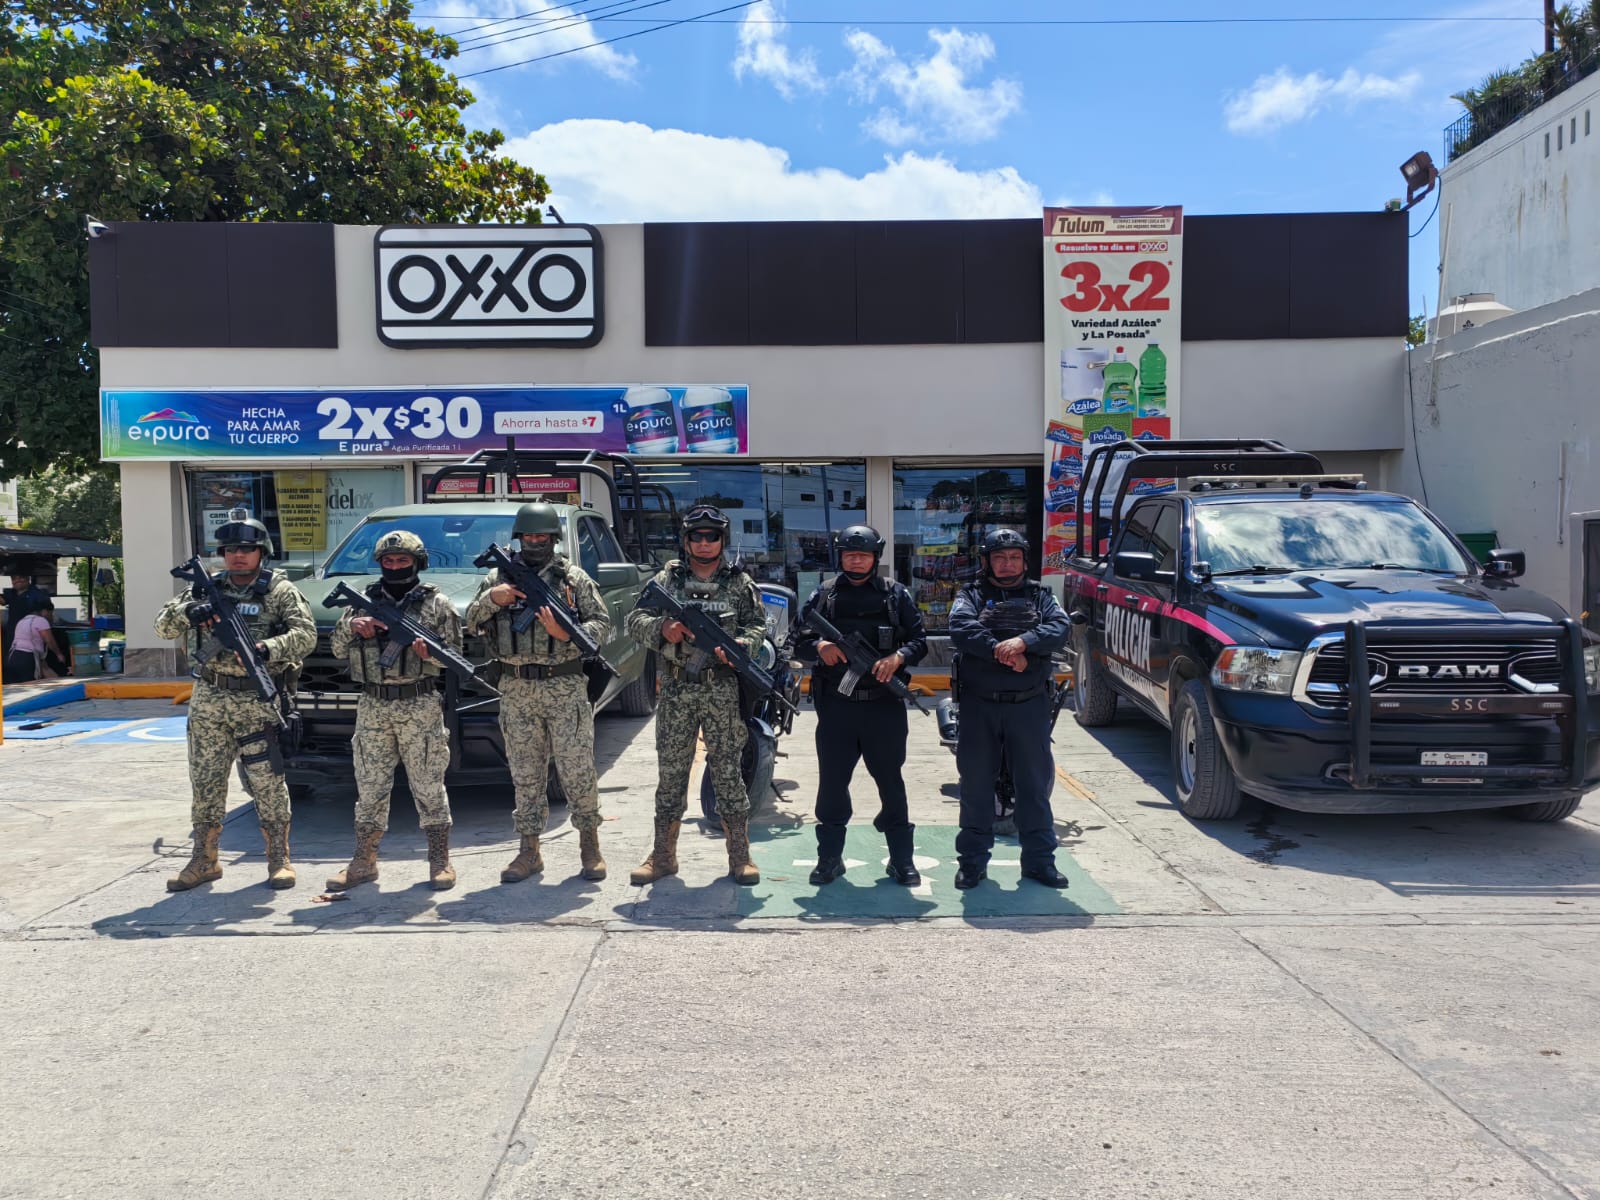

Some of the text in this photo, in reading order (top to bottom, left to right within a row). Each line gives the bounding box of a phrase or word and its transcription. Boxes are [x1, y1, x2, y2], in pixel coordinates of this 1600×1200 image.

[1058, 217, 1105, 233] Tulum
[1140, 242, 1168, 252] OXXO
[387, 247, 587, 320] OXXO
[1071, 318, 1119, 328] Variedad
[1082, 331, 1089, 340] y
[1091, 330, 1104, 339] La
[613, 403, 627, 413] 1L
[1066, 399, 1101, 413] Azálea
[242, 408, 286, 419] HECHA
[227, 420, 301, 431] PARA AMAR
[501, 416, 597, 429] Ahorra hasta $7
[229, 433, 299, 444] TU CUERPO
[1093, 432, 1122, 441] Posada
[339, 441, 348, 452] E
[391, 444, 410, 452] Agua
[412, 443, 450, 452] Purificada
[520, 480, 570, 489] Bienvenido
[1105, 602, 1151, 673] POLICÍA
[1398, 664, 1500, 679] RAM
